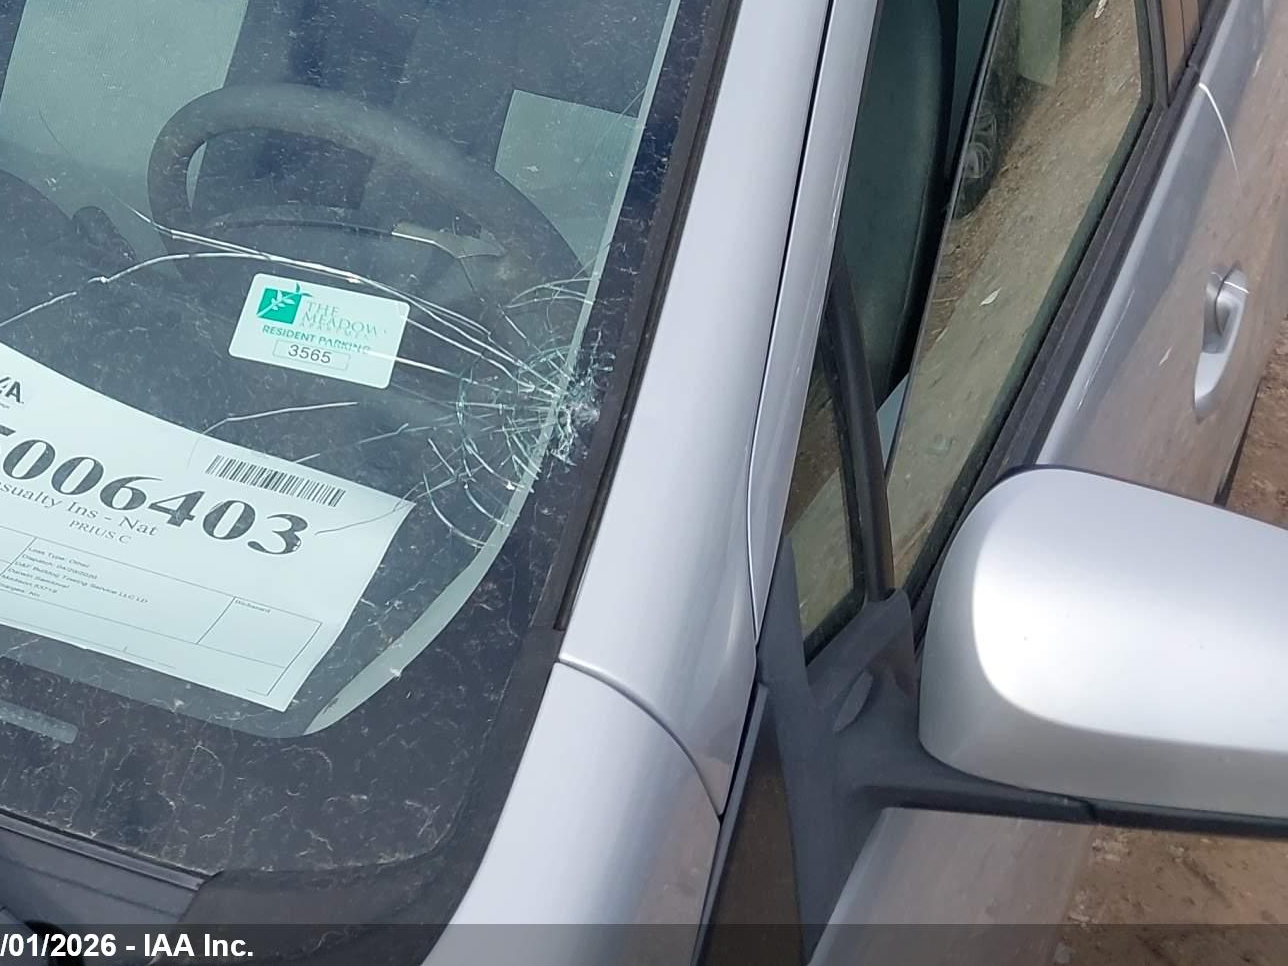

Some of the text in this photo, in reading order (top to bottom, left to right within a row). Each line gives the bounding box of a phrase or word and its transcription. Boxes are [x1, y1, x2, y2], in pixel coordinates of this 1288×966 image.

[306, 301, 340, 316] THE
[263, 324, 317, 343] RESIDENT
[288, 344, 332, 364] 3565
[67, 501, 99, 518] Ins
[119, 516, 158, 536] Nat
[69, 520, 116, 540] PRIUS
[118, 534, 132, 545] C
